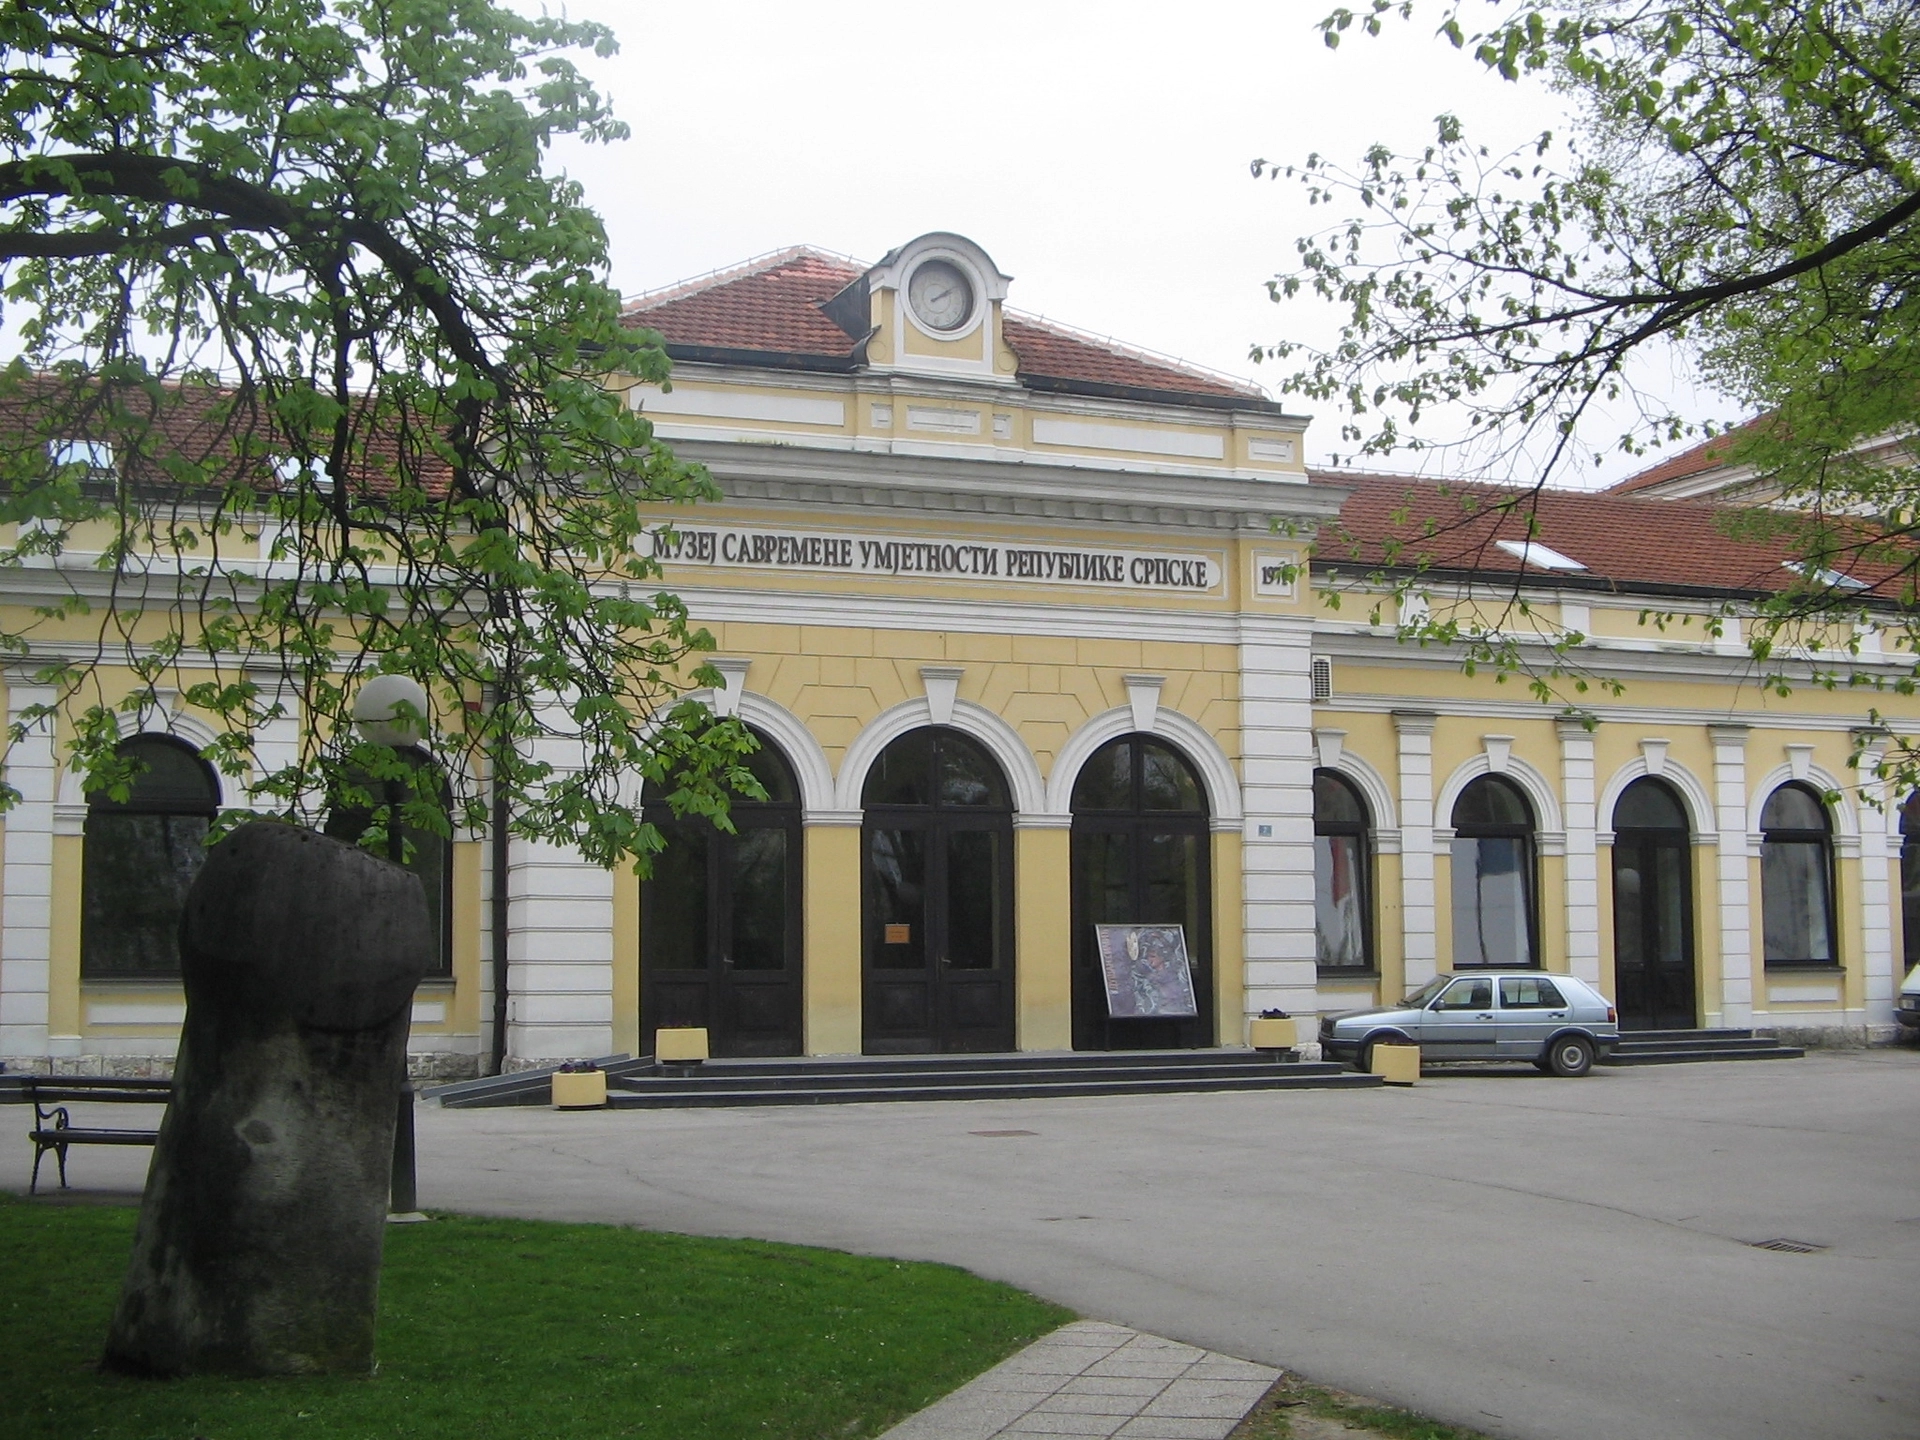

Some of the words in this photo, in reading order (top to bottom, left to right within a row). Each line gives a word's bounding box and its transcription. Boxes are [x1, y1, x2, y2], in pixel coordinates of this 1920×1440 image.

[651, 529, 717, 564] МУЗЕЈ
[722, 533, 853, 566] САВРЕМЕНЕ
[858, 540, 999, 575] УМЈЕТНОСТИ
[1006, 549, 1124, 582] РЕПУБЛИКЕ
[1130, 557, 1208, 587] СРПСКЕ
